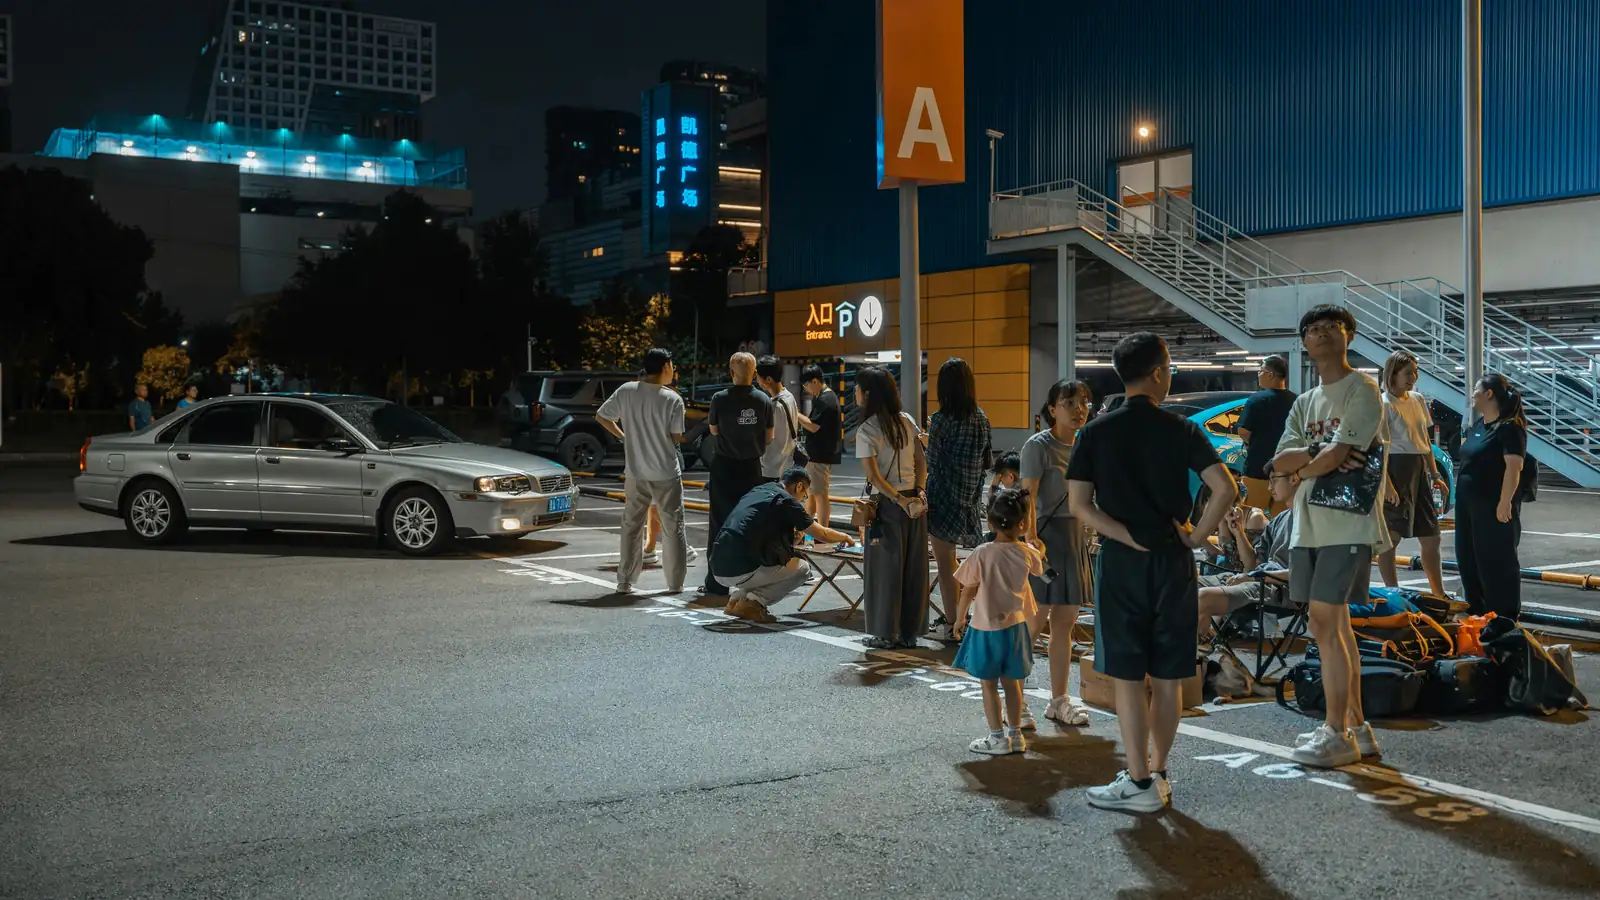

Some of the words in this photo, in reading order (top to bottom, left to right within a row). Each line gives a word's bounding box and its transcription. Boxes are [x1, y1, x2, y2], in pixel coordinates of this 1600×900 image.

[897, 86, 953, 162] A
[806, 303, 832, 327] 入口
[805, 330, 832, 340] Entrance
